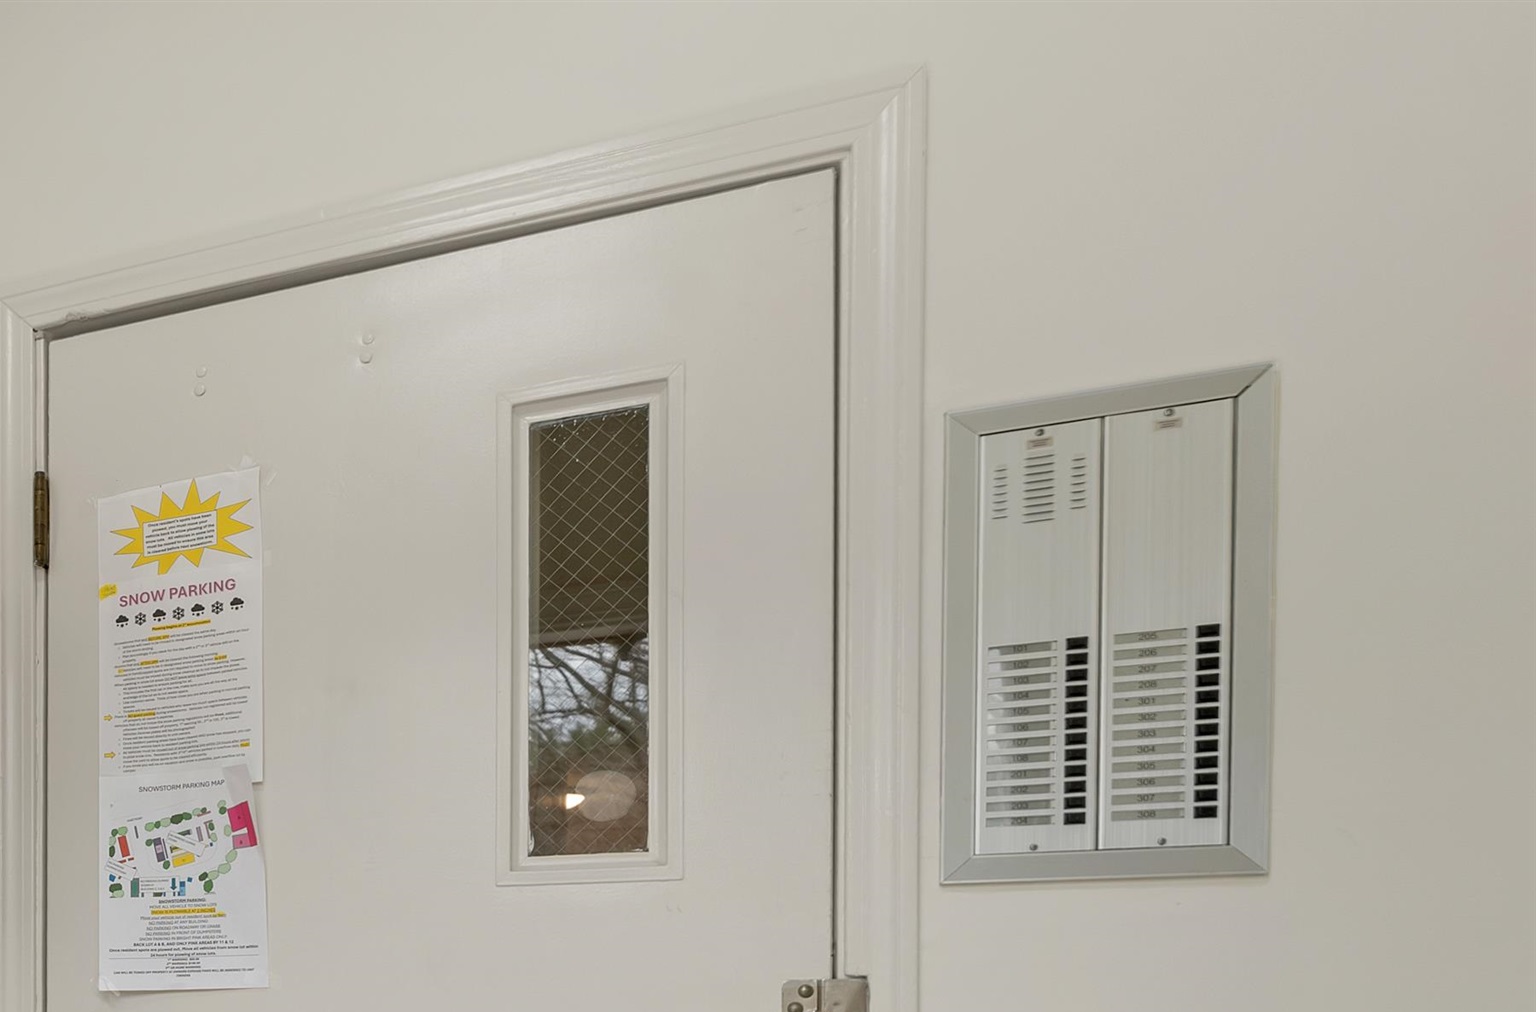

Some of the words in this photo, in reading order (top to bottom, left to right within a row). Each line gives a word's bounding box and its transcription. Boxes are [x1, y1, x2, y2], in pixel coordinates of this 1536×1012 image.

[119, 589, 166, 608] SNOW
[169, 578, 236, 600] PARKING
[1138, 648, 1157, 657] 206
[1138, 664, 1157, 673] 207
[1138, 697, 1155, 705] 301
[1136, 745, 1155, 754] 304
[138, 784, 181, 792] SNOWSTORM
[182, 781, 210, 789] PARKING
